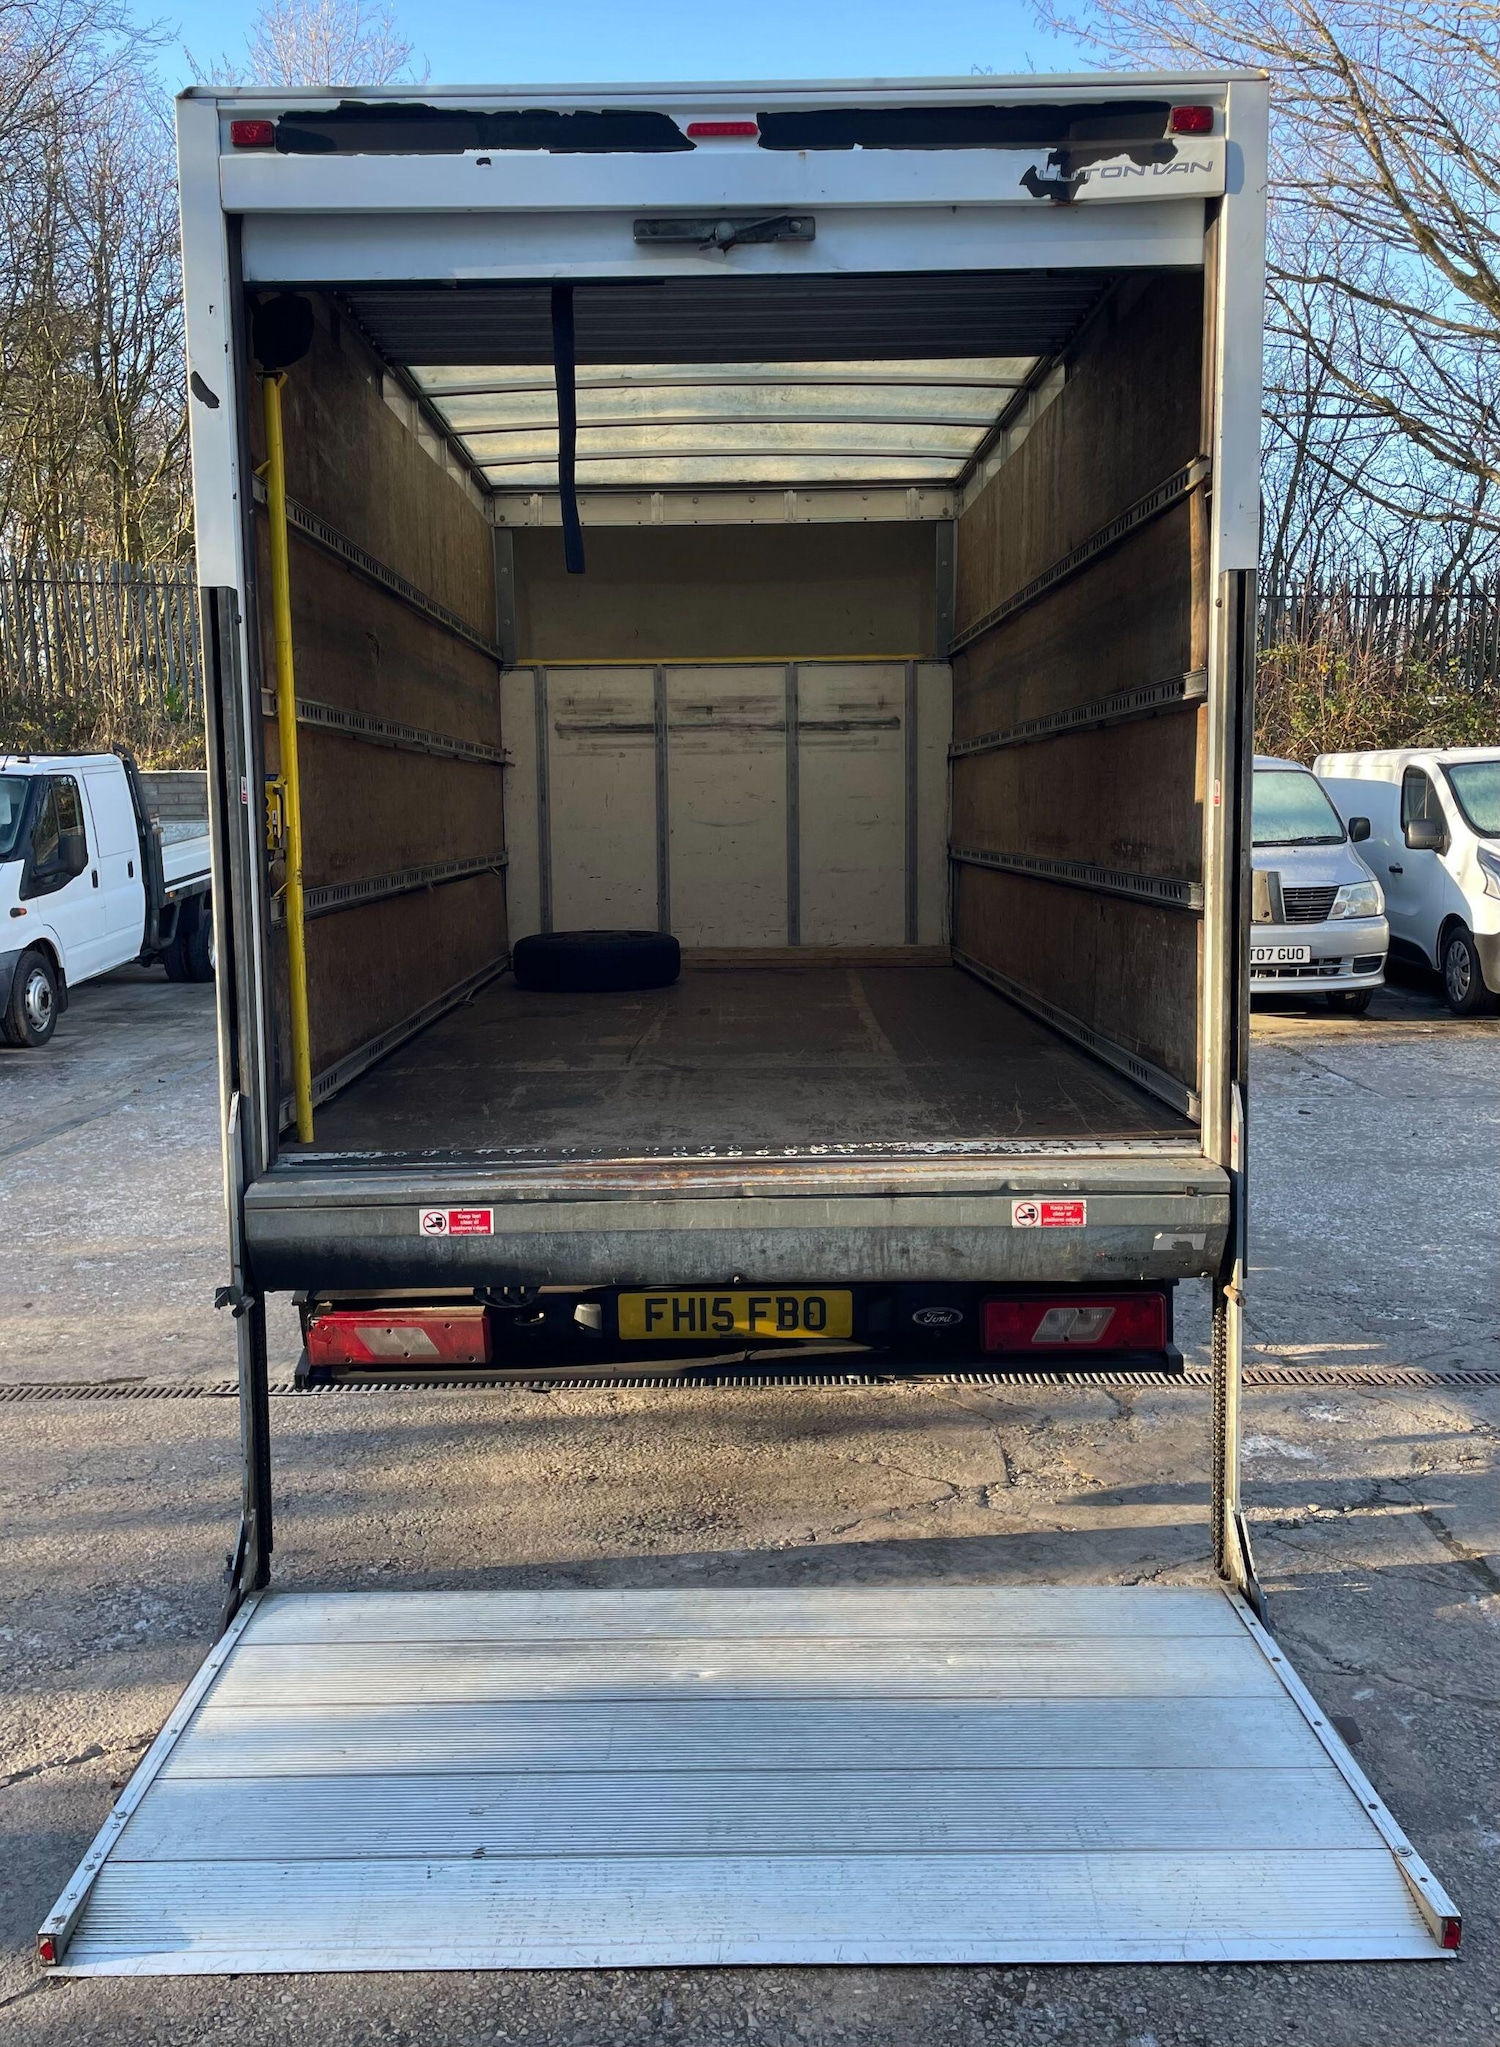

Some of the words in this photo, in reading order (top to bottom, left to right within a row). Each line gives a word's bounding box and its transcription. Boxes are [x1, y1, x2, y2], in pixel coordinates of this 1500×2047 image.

[1153, 161, 1213, 175] VAN
[1278, 948, 1304, 960] GUO
[645, 1297, 734, 1332] FH15
[748, 1296, 827, 1332] FBO
